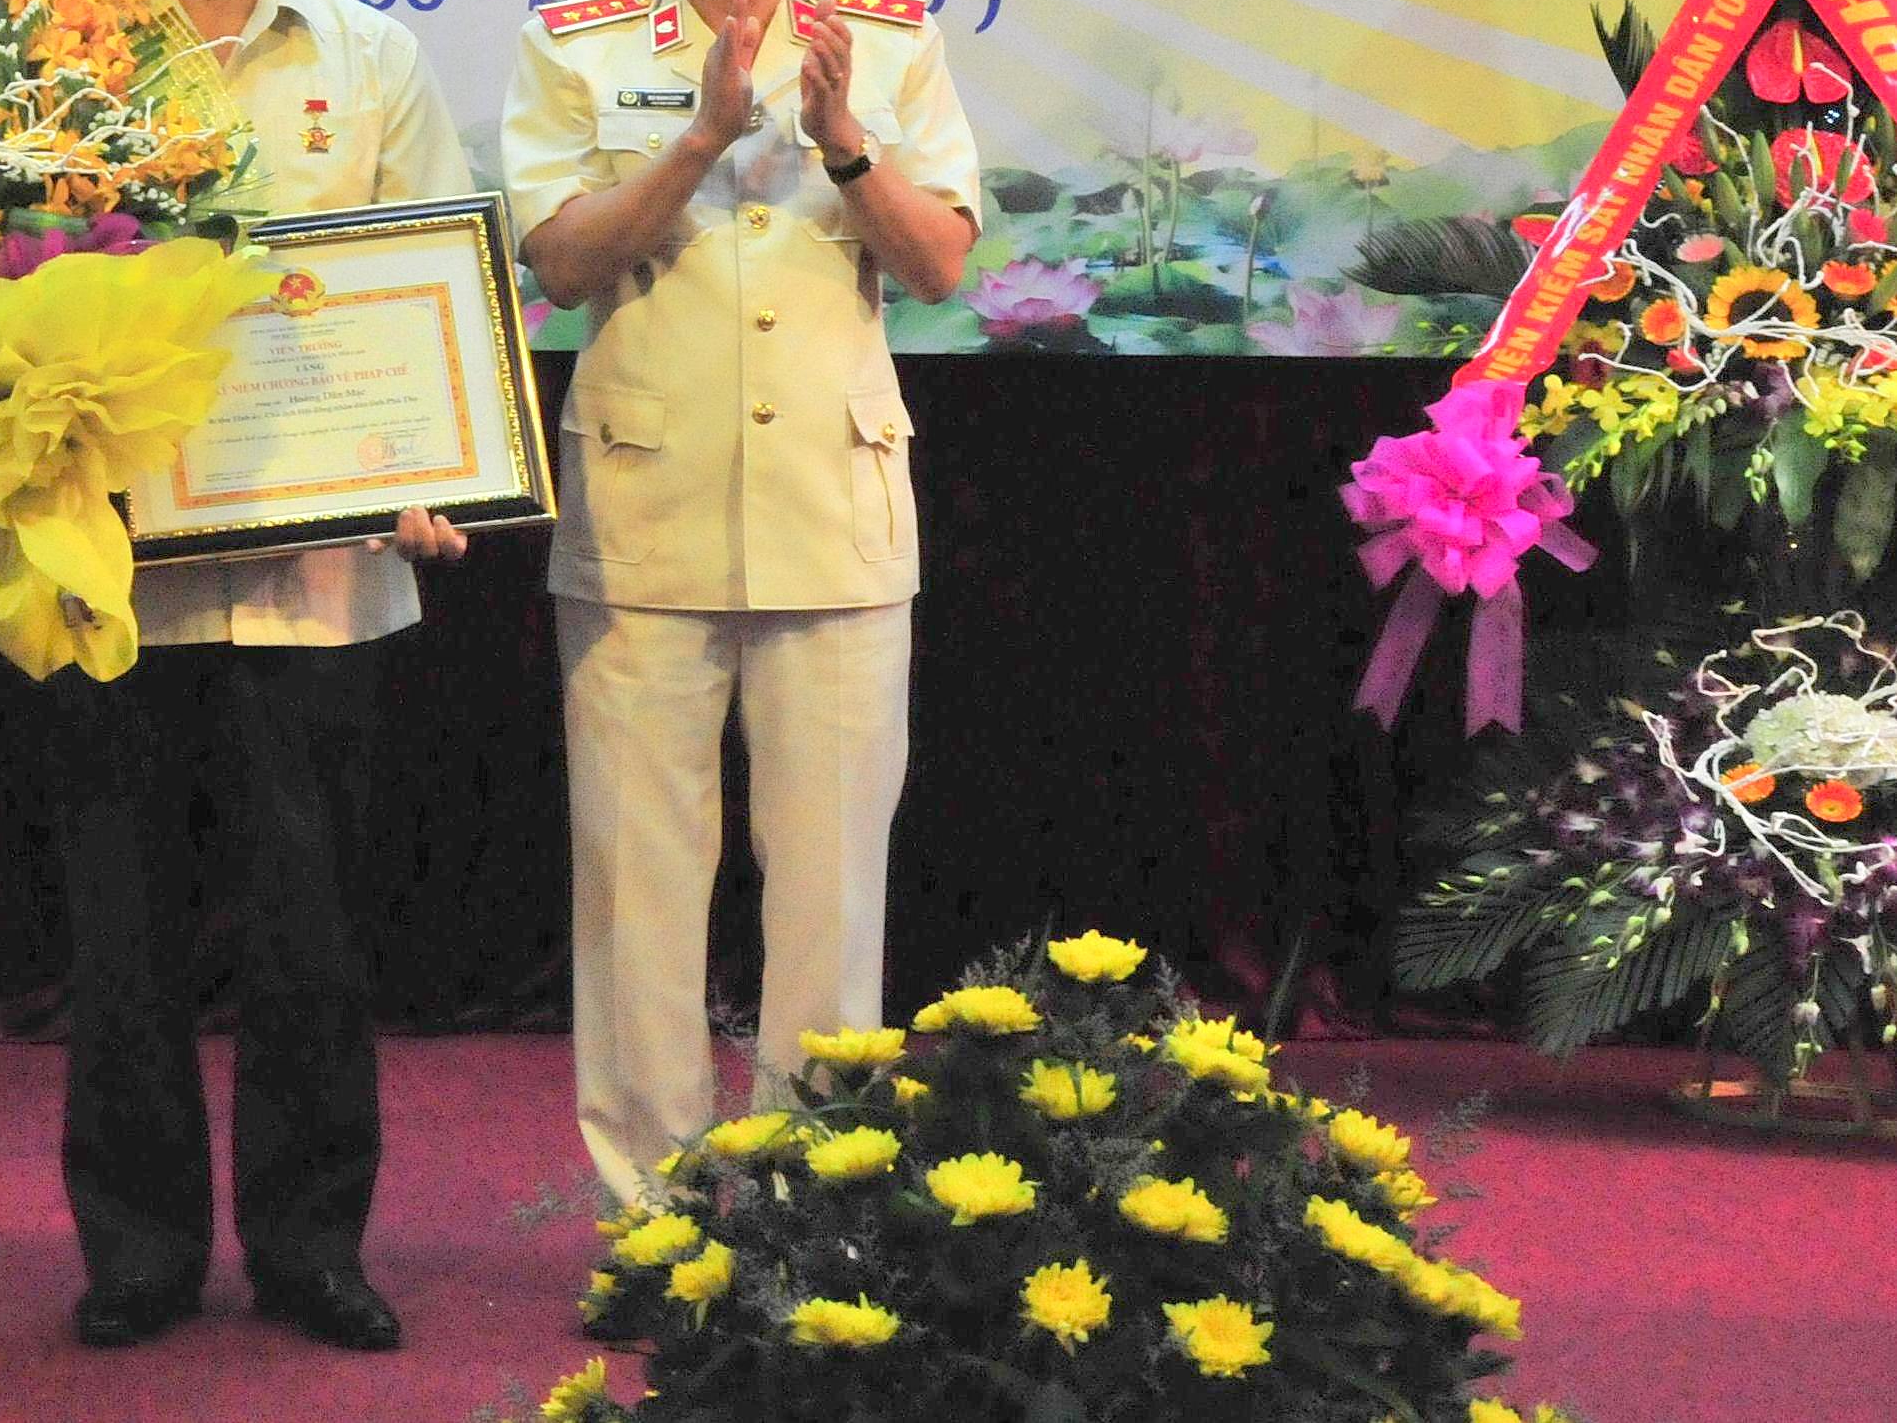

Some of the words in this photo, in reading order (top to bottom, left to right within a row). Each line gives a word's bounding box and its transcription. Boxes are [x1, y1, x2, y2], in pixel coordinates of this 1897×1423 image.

[1484, 327, 1543, 380] IỆN
[1525, 248, 1593, 324] KIỂM
[1612, 102, 1684, 186] NHÂN
[1665, 33, 1724, 99] DÂN
